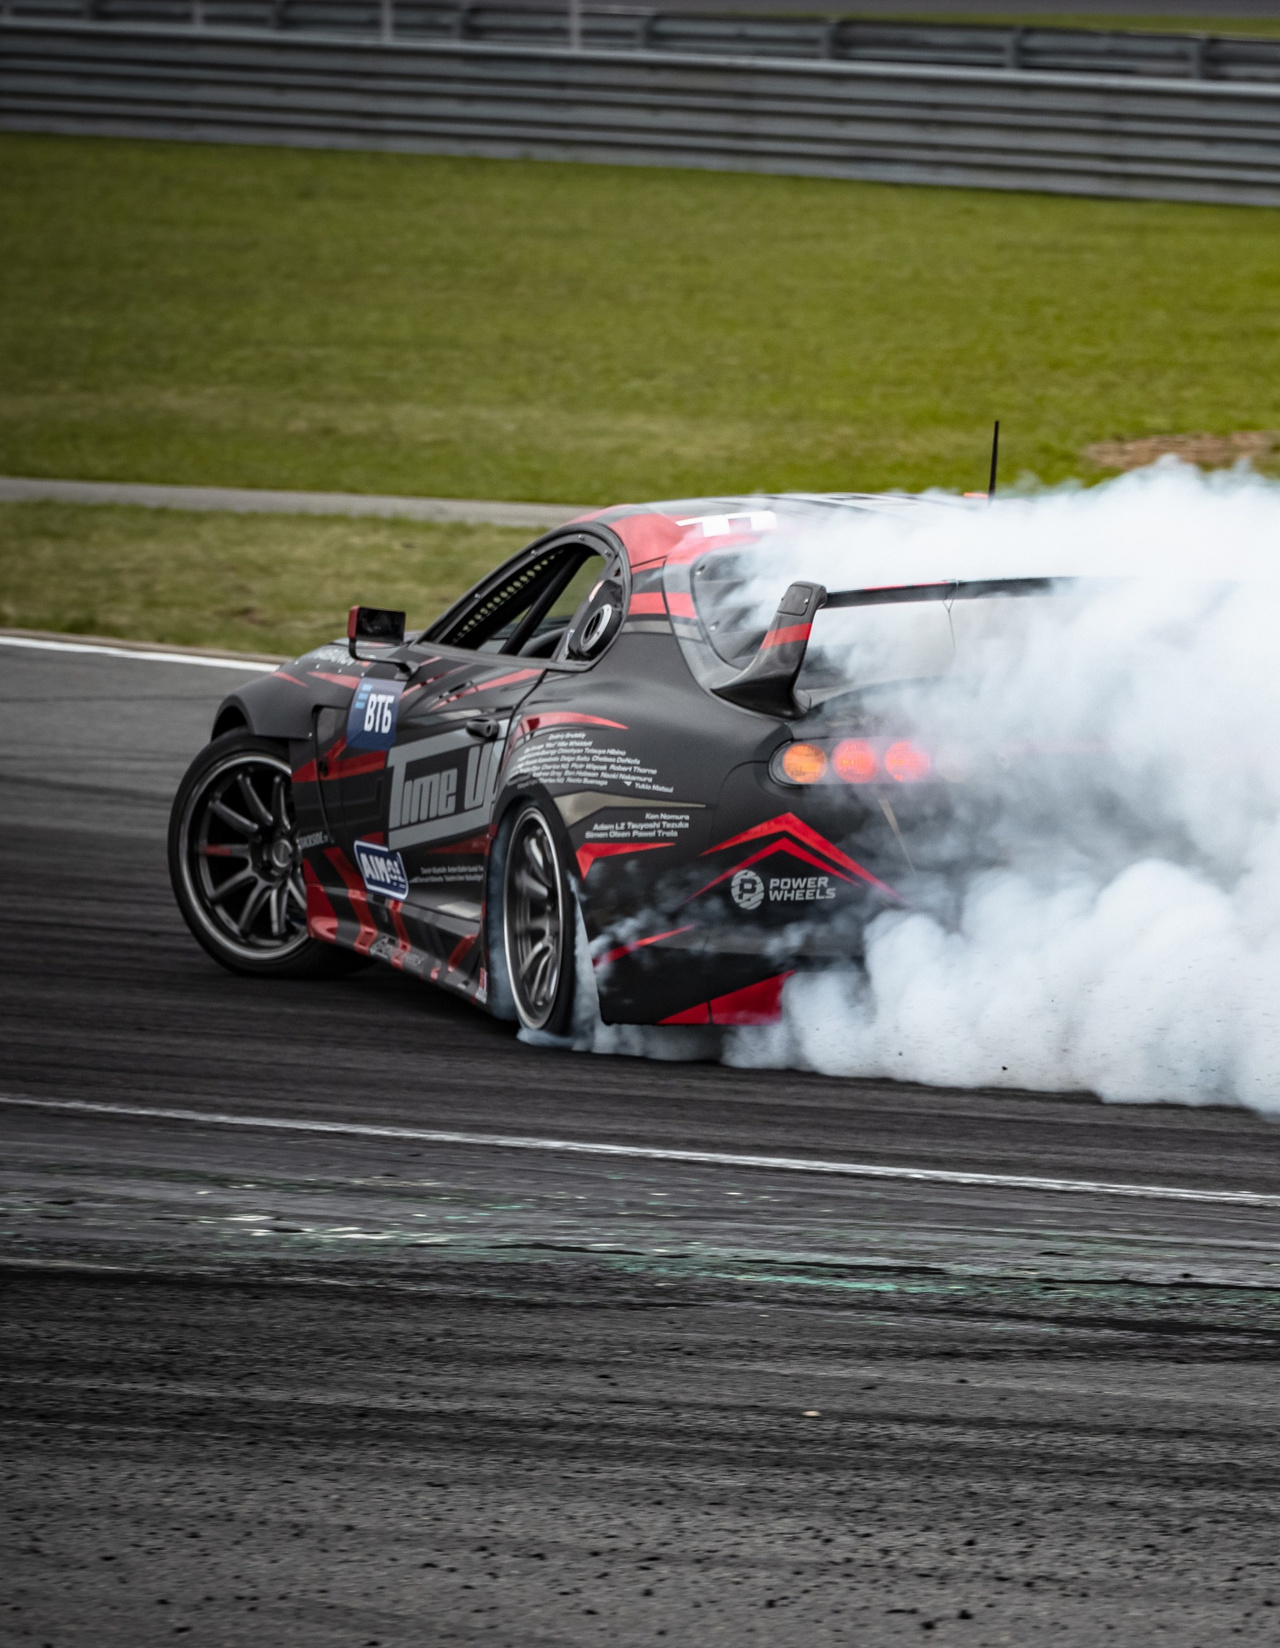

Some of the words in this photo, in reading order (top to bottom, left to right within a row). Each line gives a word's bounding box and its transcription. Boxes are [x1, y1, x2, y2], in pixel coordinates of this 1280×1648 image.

[364, 693, 394, 734] ВТБ
[591, 755, 616, 763] Chelsea
[609, 763, 633, 773] Robert
[632, 765, 657, 775] Thorne
[619, 773, 653, 783] Nakamura
[635, 782, 652, 791] Yukio
[652, 783, 674, 793] Matsui
[645, 812, 659, 820] Ken
[660, 812, 690, 820] Nomura
[593, 823, 615, 831] Adam
[615, 821, 626, 830] LZ
[627, 821, 661, 830] Tsuyoshi
[662, 821, 689, 829] Tezuka
[609, 830, 631, 838] Olsen
[657, 830, 678, 838] Trela
[769, 876, 829, 890] POWER
[769, 887, 836, 902] WHEELS
